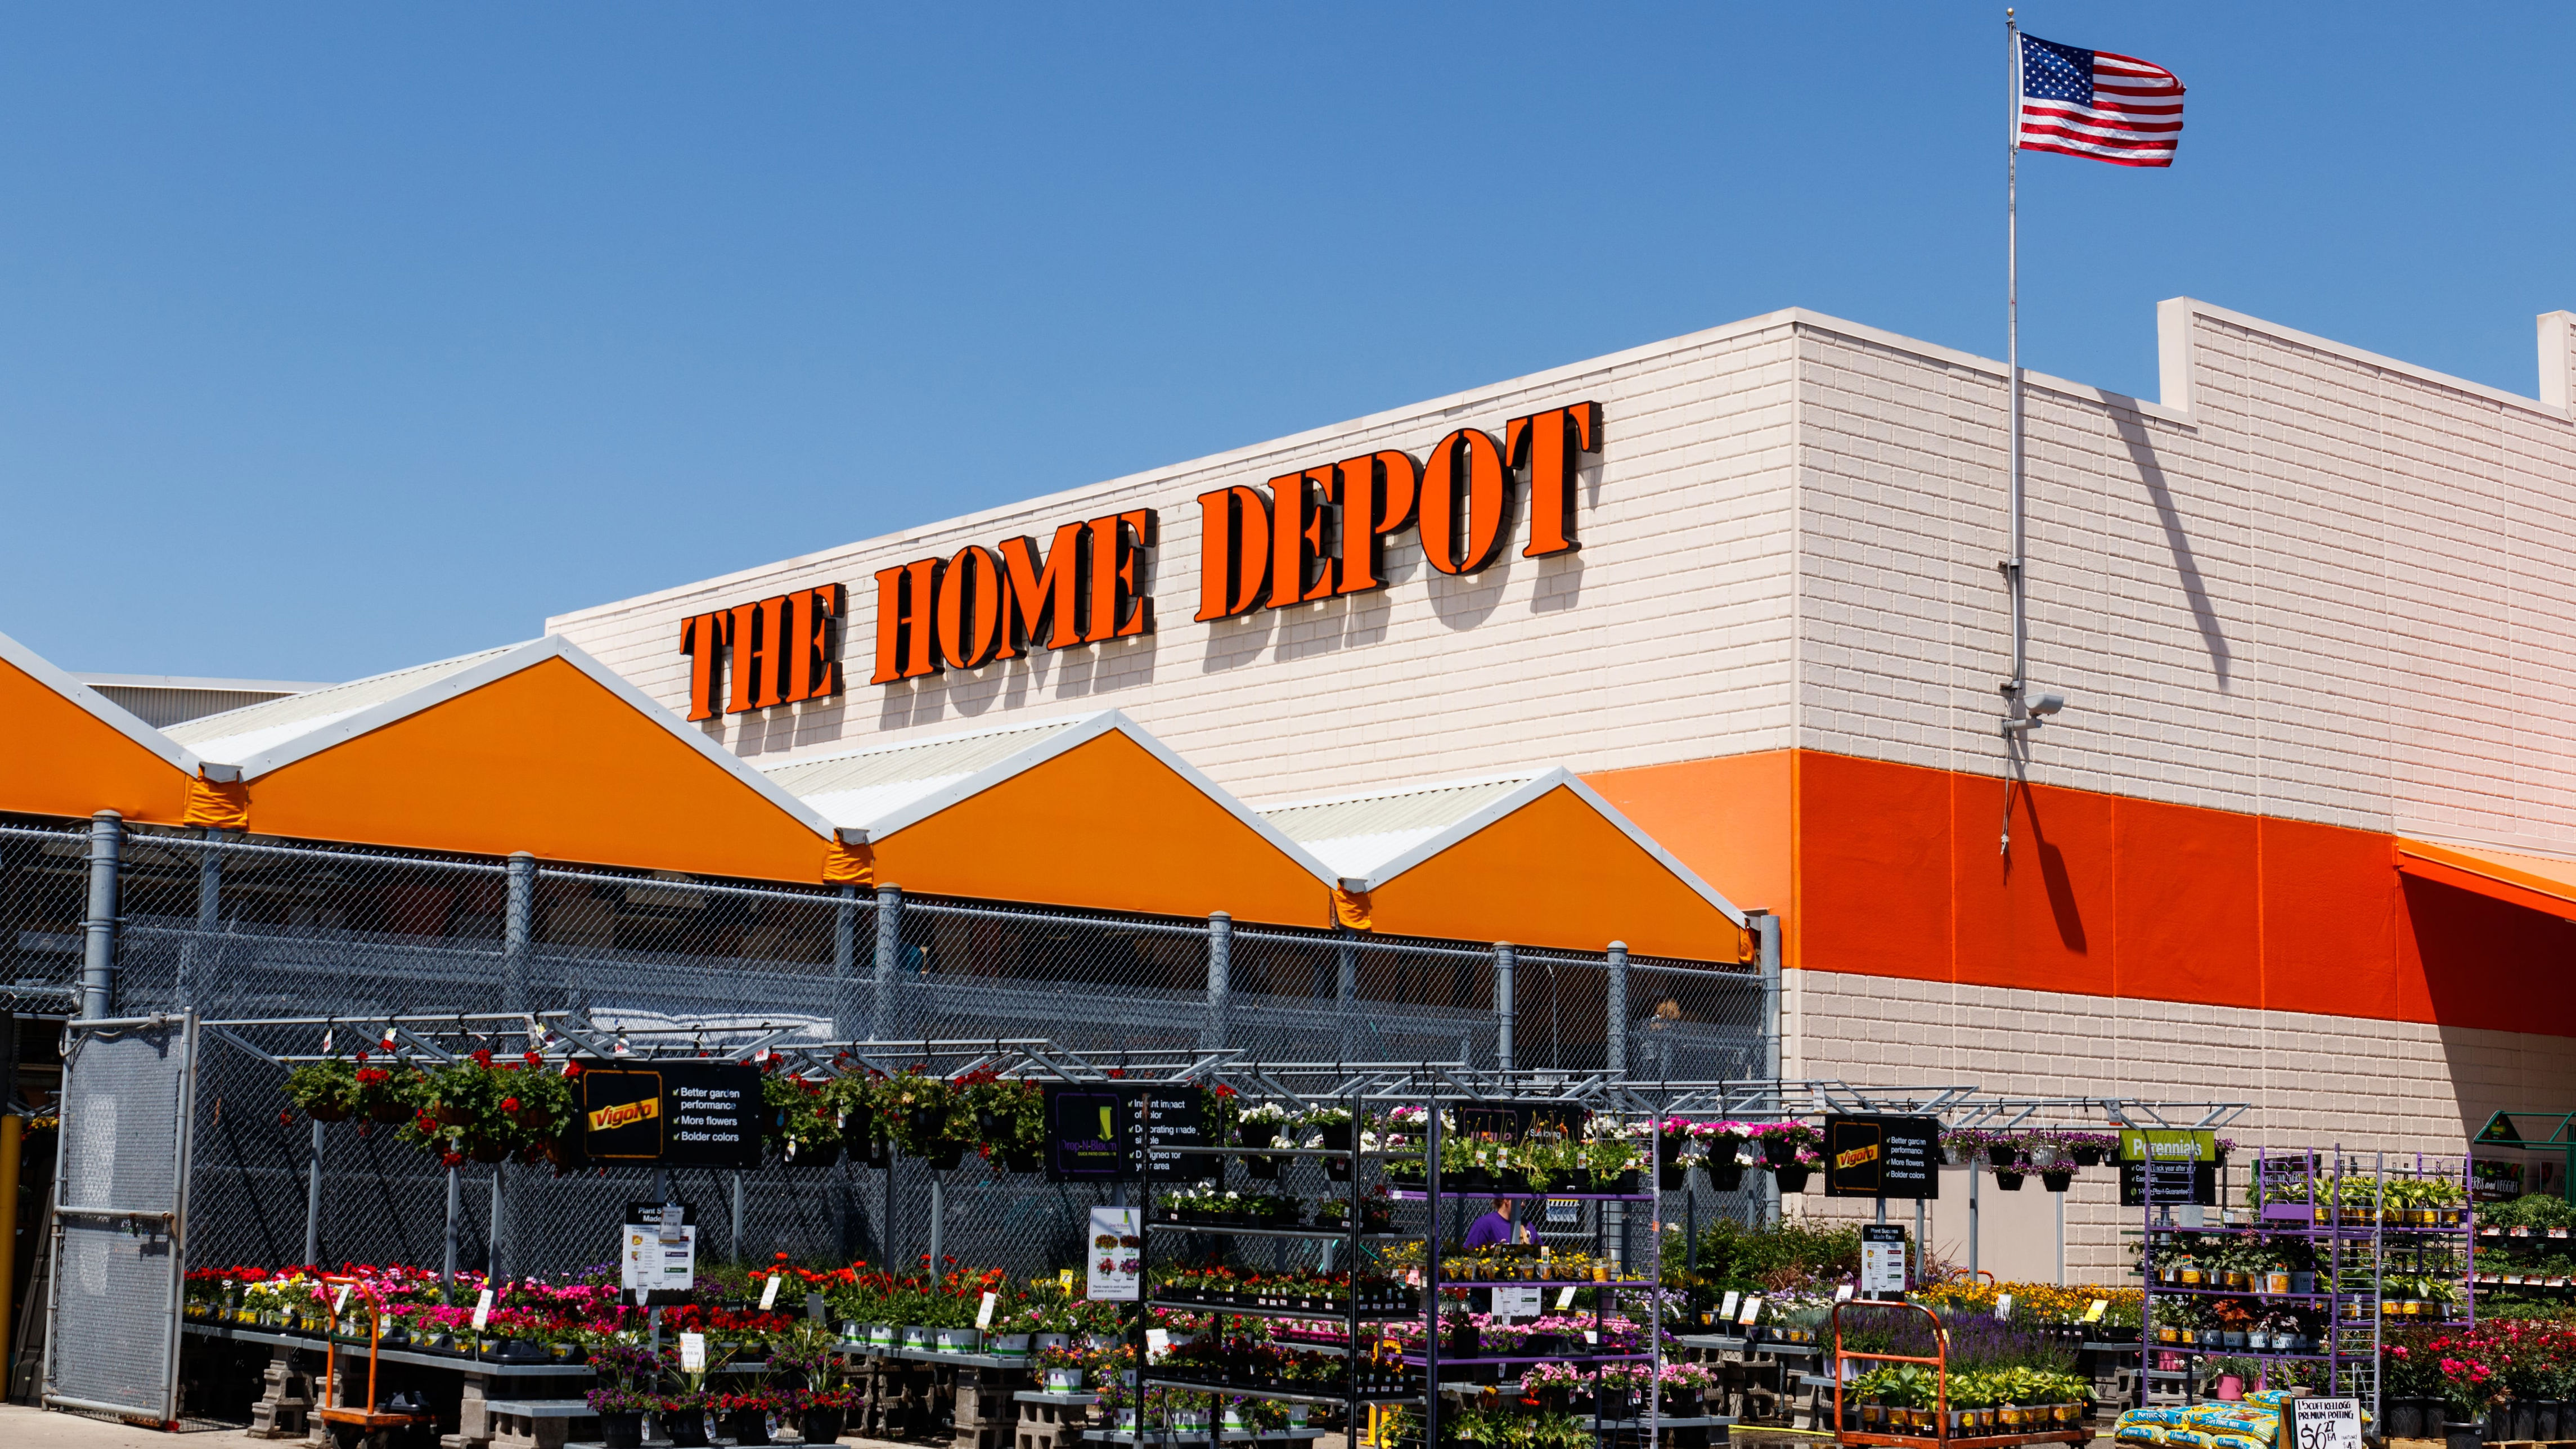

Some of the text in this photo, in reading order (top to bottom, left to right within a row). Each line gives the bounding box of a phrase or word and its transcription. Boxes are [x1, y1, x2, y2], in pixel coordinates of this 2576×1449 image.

[680, 400, 1602, 722] THE HOME DEPOT
[681, 1087, 740, 1100] Better garden
[681, 1100, 736, 1110] performance
[1134, 1099, 1185, 1110] Insnt impact
[595, 1103, 652, 1128] Vigoro
[1134, 1110, 1162, 1119] of lor
[681, 1115, 738, 1126] More flowers
[1135, 1124, 1196, 1135] Dorating made
[1543, 1129, 1561, 1140] lovng
[681, 1131, 739, 1142] Bolder colors
[1135, 1136, 1159, 1145] sile
[1891, 1136, 1926, 1147] Better garden
[1135, 1150, 1170, 1160] Digned
[1891, 1146, 1923, 1155] performance
[1841, 1149, 1874, 1166] Vigoro
[1136, 1163, 1152, 1171] yr
[1905, 1159, 1925, 1167] flowers
[2470, 1175, 2519, 1193] ERBS and VEGGIES
[2324, 1401, 2351, 1410] KELLOGG
[2298, 1411, 2354, 1420] PREMIUM POTTING
[2229, 1420, 2240, 1428] MIX
[2327, 1433, 2336, 1441] EA
